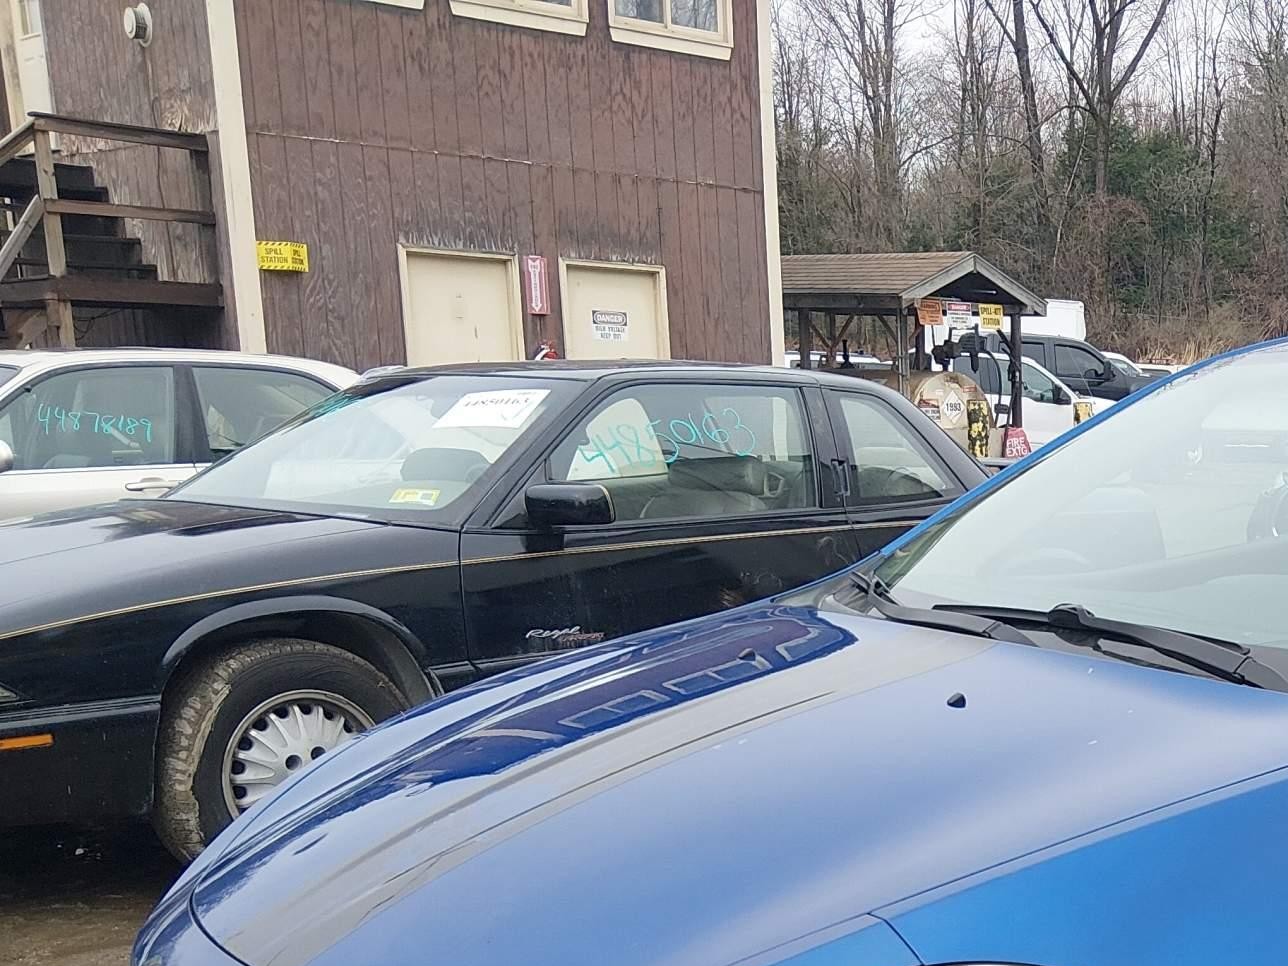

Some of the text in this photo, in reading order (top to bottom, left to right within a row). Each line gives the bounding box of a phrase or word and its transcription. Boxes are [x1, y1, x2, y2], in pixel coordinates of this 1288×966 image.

[264, 247, 283, 256] SPILL
[260, 256, 289, 264] STATION
[596, 313, 623, 323] DANGER
[945, 402, 962, 412] 1993
[38, 403, 152, 442] 44878189
[578, 407, 757, 474] 44850163
[1006, 437, 1026, 448] FIRE
[1006, 447, 1028, 457] EXTG
